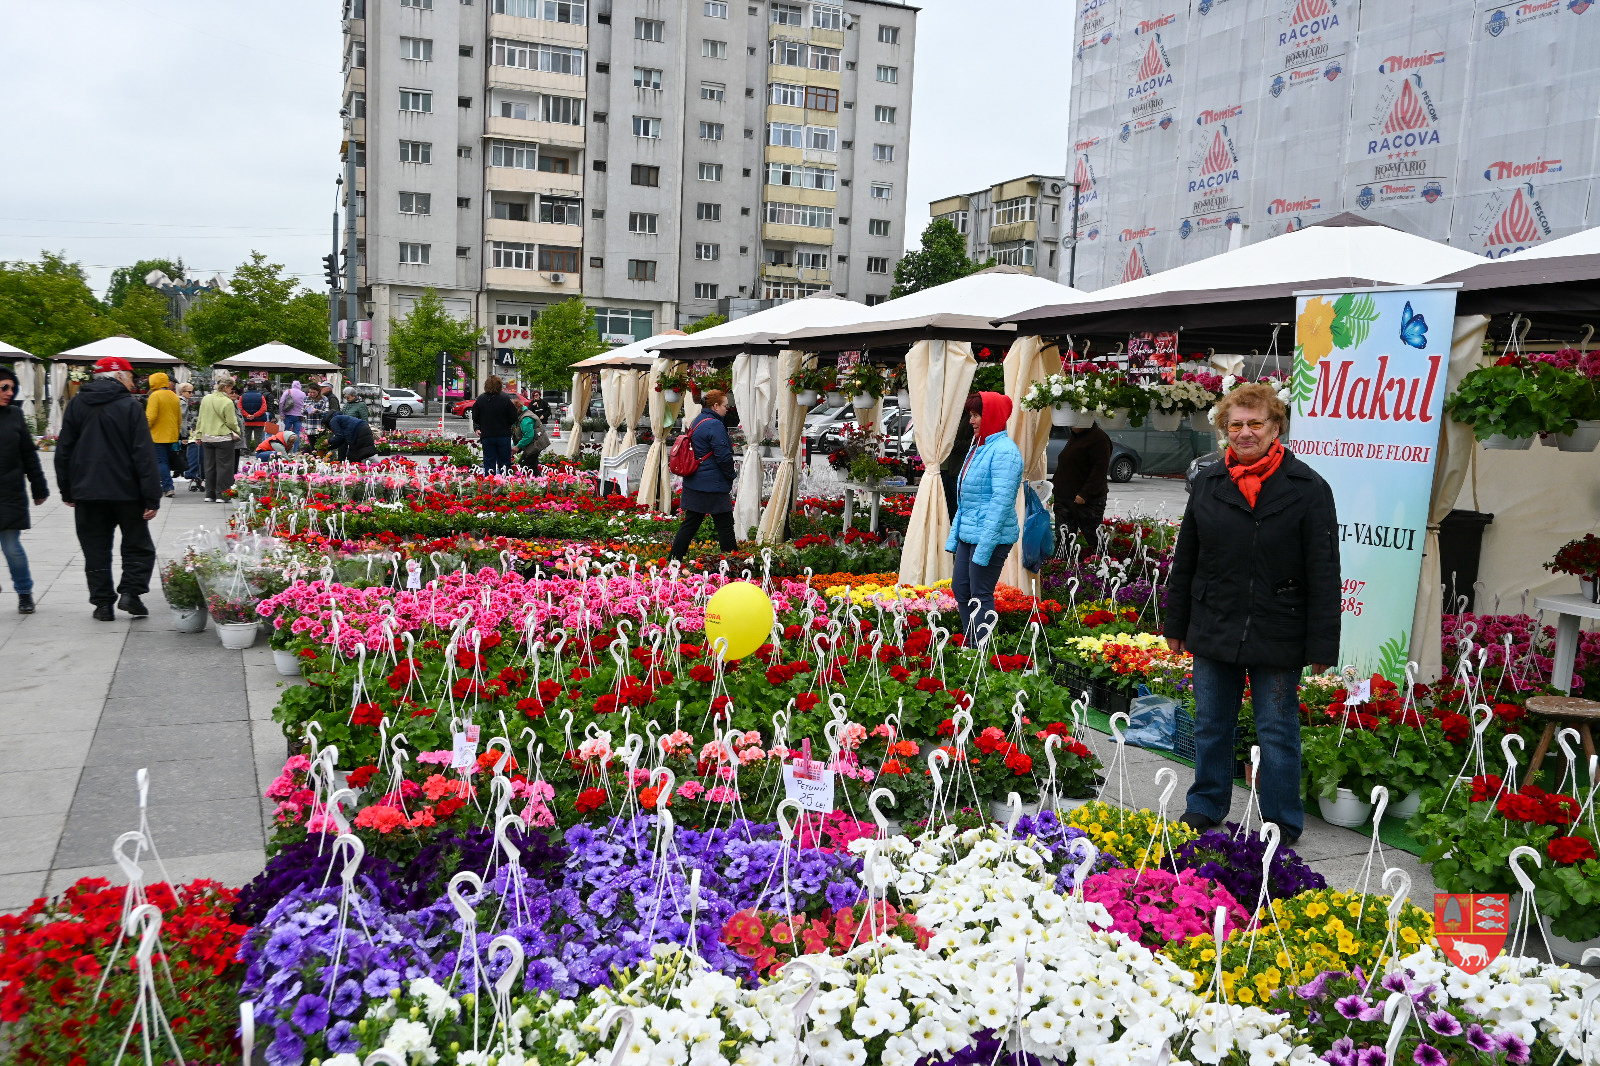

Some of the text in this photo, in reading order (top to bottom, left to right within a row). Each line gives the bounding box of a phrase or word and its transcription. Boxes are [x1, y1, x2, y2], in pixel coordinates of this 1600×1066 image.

[1137, 14, 1175, 34] Nomis
[1279, 14, 1339, 46] RACOVA
[1382, 50, 1444, 74] Nomis
[1128, 74, 1173, 99] RACOVA
[1200, 105, 1242, 125] Nomis
[1422, 91, 1438, 123] PESCOM
[1368, 130, 1440, 154] RACOVA
[1487, 156, 1561, 180] Nomis
[1188, 169, 1240, 193] RACOVA
[1382, 184, 1415, 195] Nomis
[1272, 196, 1320, 214] Nomis
[1533, 200, 1551, 236] PESCOM
[1124, 226, 1156, 241] Nomis
[1141, 255, 1151, 276] PESCO
[1308, 355, 1442, 423] Makul
[1289, 438, 1431, 463] PRODUCĂTOR DE FLORI
[1338, 523, 1417, 551] I-VASLUI
[1340, 578, 1366, 596] 497
[799, 792, 815, 807] 25
